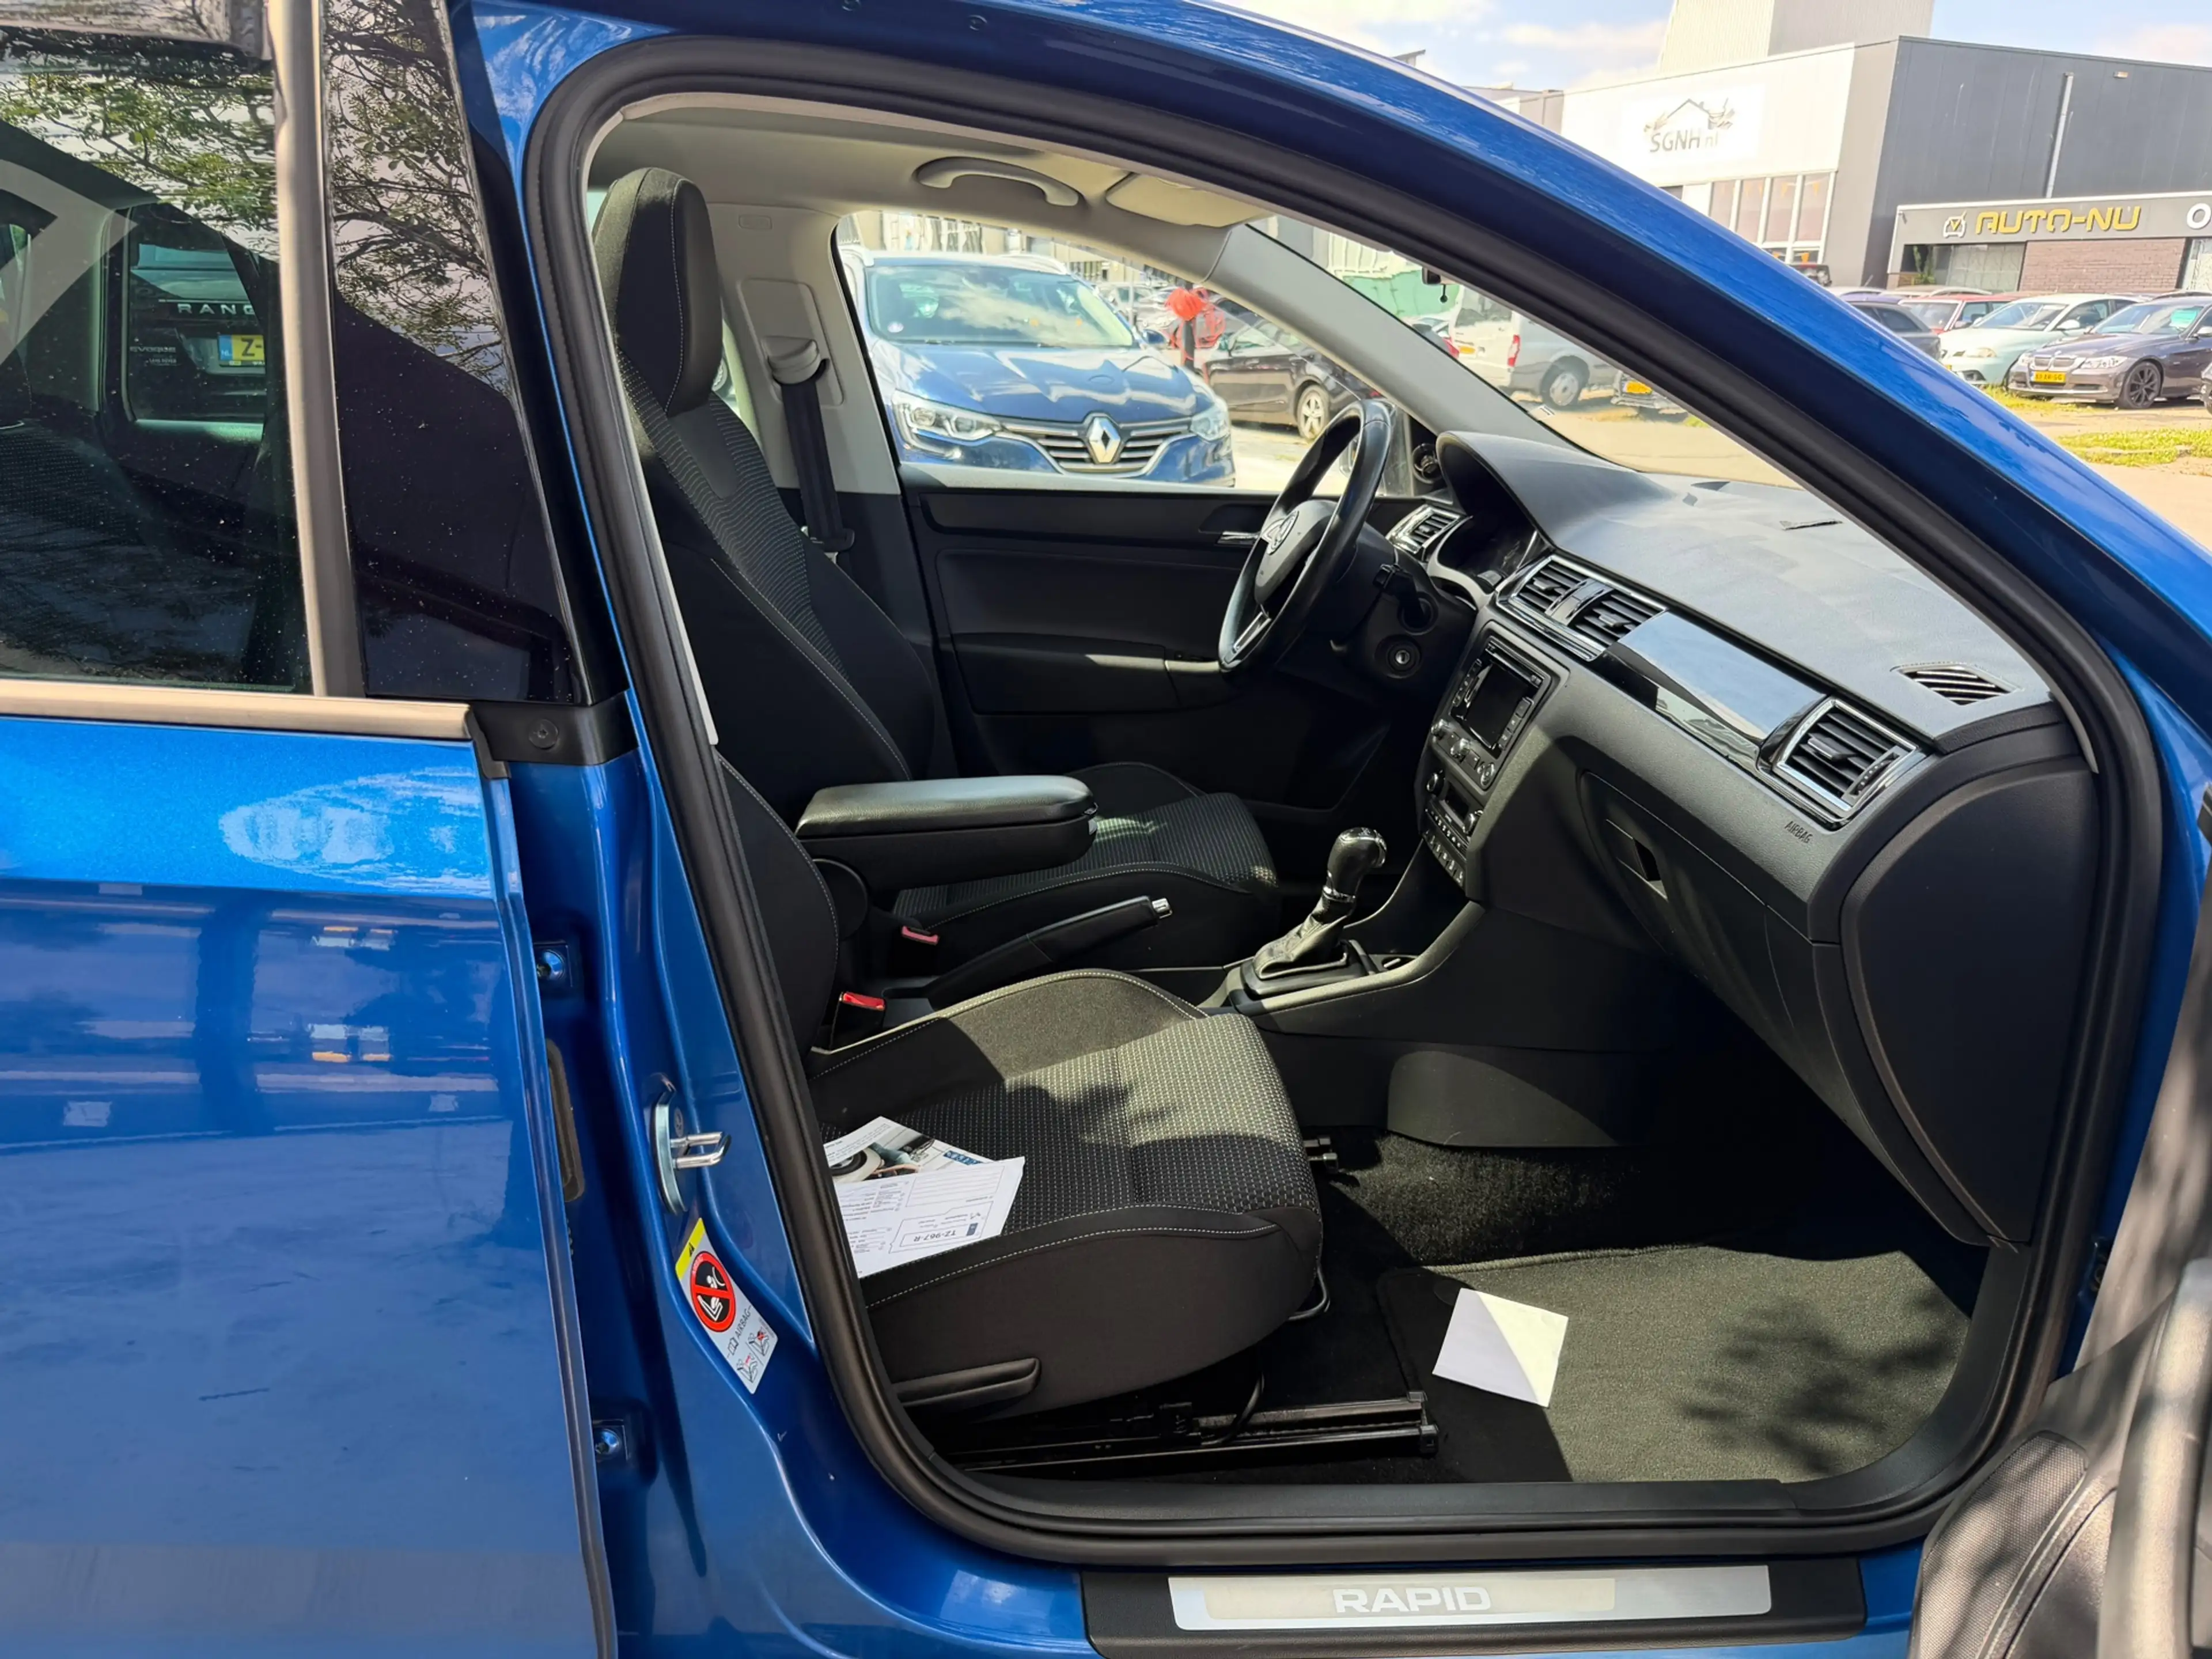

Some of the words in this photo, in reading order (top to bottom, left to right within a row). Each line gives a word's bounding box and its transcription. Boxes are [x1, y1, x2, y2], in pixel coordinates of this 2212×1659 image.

[1975, 205, 2141, 236] AUTO-NU
[1784, 820, 1813, 844] AIRBAG
[734, 1308, 751, 1340] AIRBAG
[1332, 1586, 1492, 1613] RAPID
